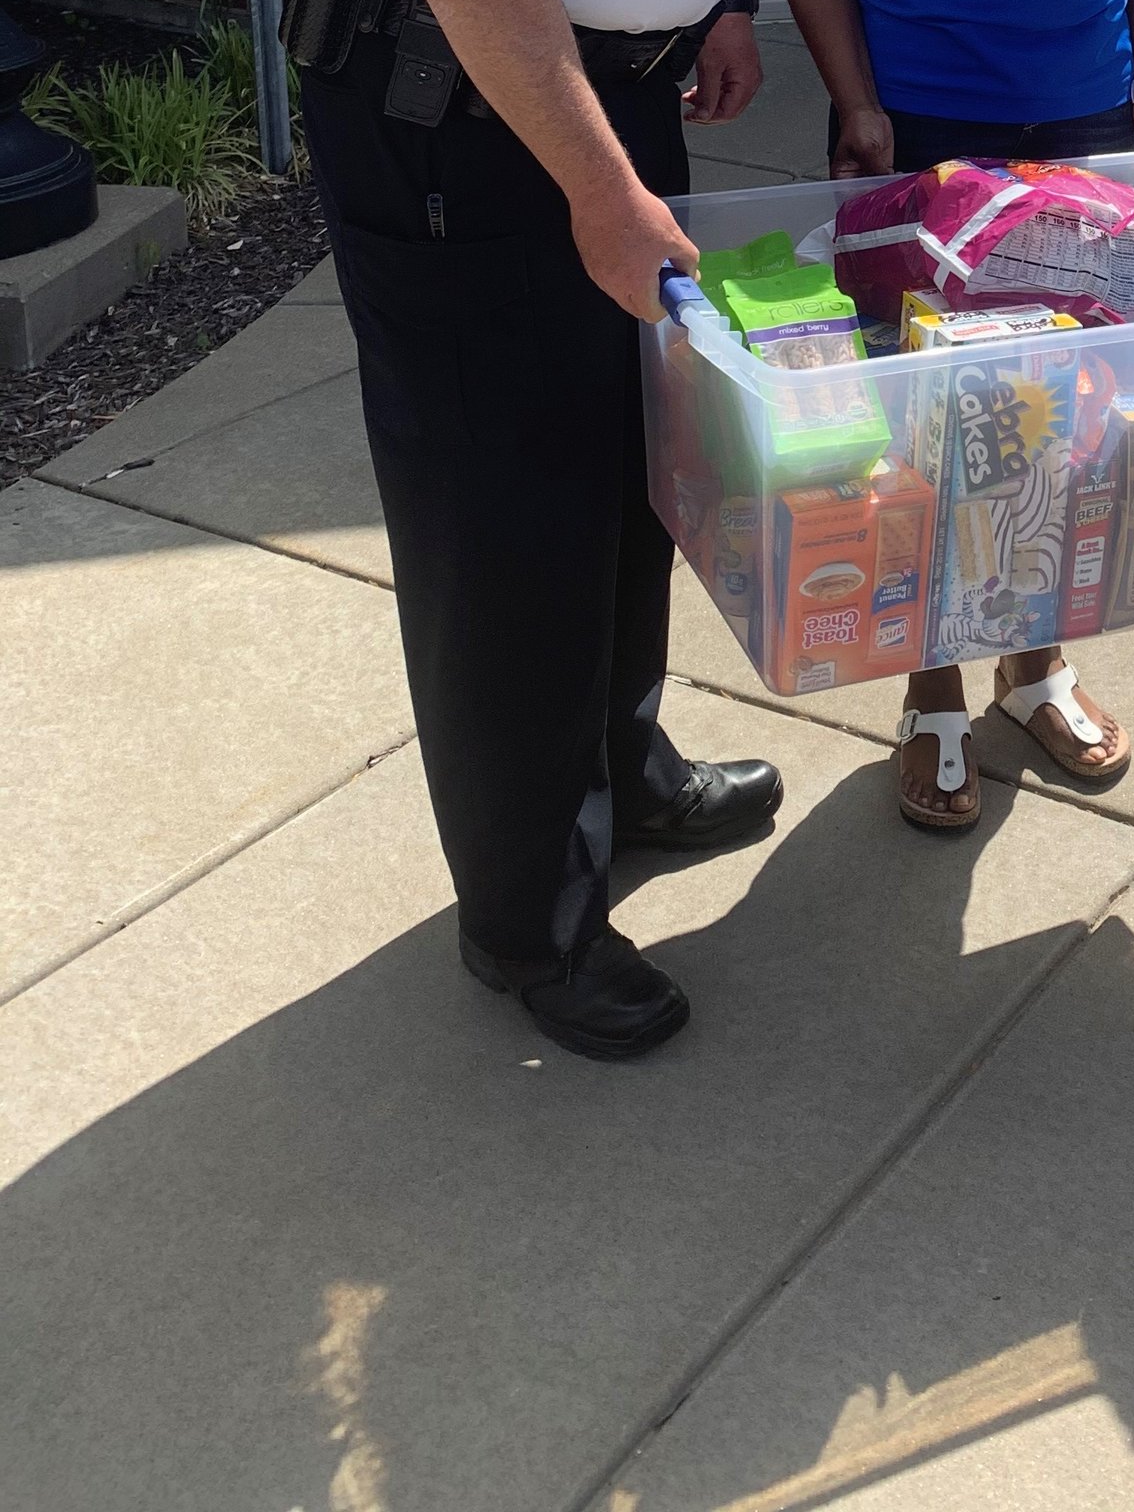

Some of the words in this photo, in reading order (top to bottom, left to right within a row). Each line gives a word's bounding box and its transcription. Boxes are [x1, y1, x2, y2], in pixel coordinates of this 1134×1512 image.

[1035, 215, 1047, 223] 150
[768, 300, 844, 321] rollers
[779, 325, 804, 335] mixed
[806, 324, 829, 332] berry
[955, 365, 992, 485] Cakes
[1076, 503, 1113, 521] BEEF
[879, 591, 907, 604] Peanut
[883, 584, 907, 594] Butter
[805, 609, 860, 631] Chee
[802, 627, 859, 650] Toast
[877, 619, 910, 645] Lance
